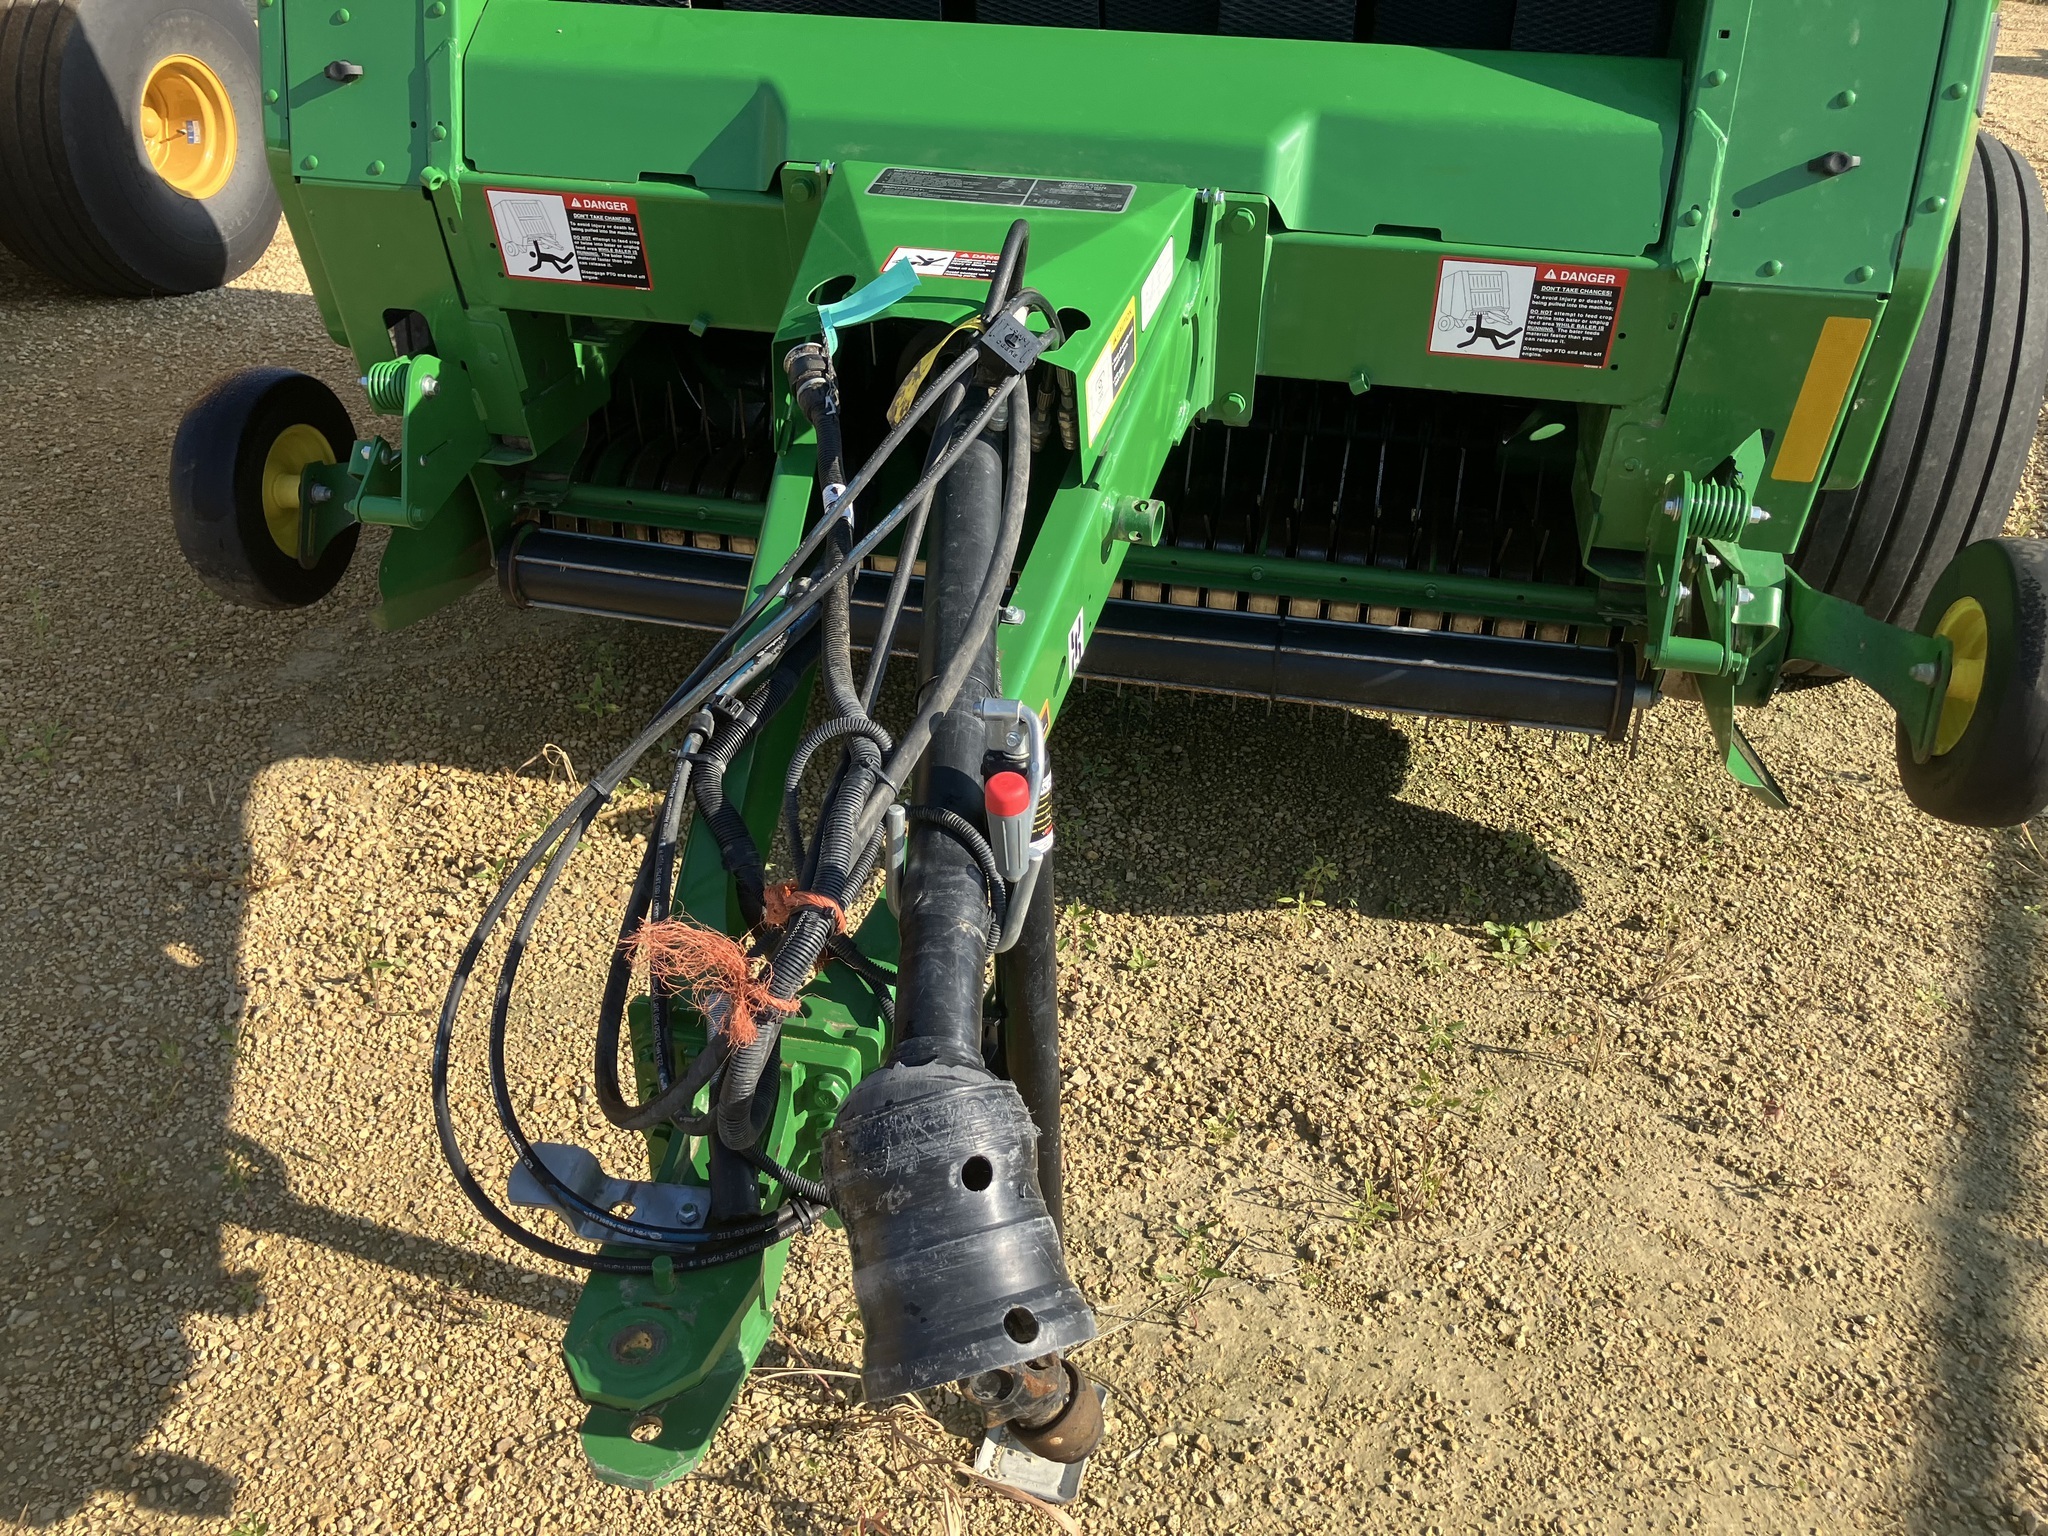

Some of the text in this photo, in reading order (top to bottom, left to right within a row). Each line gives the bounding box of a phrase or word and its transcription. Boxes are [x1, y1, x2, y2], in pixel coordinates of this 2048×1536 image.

[583, 199, 628, 211] DANGER
[1560, 271, 1615, 284] DANGER
[1580, 288, 1612, 297] CHANCES!
